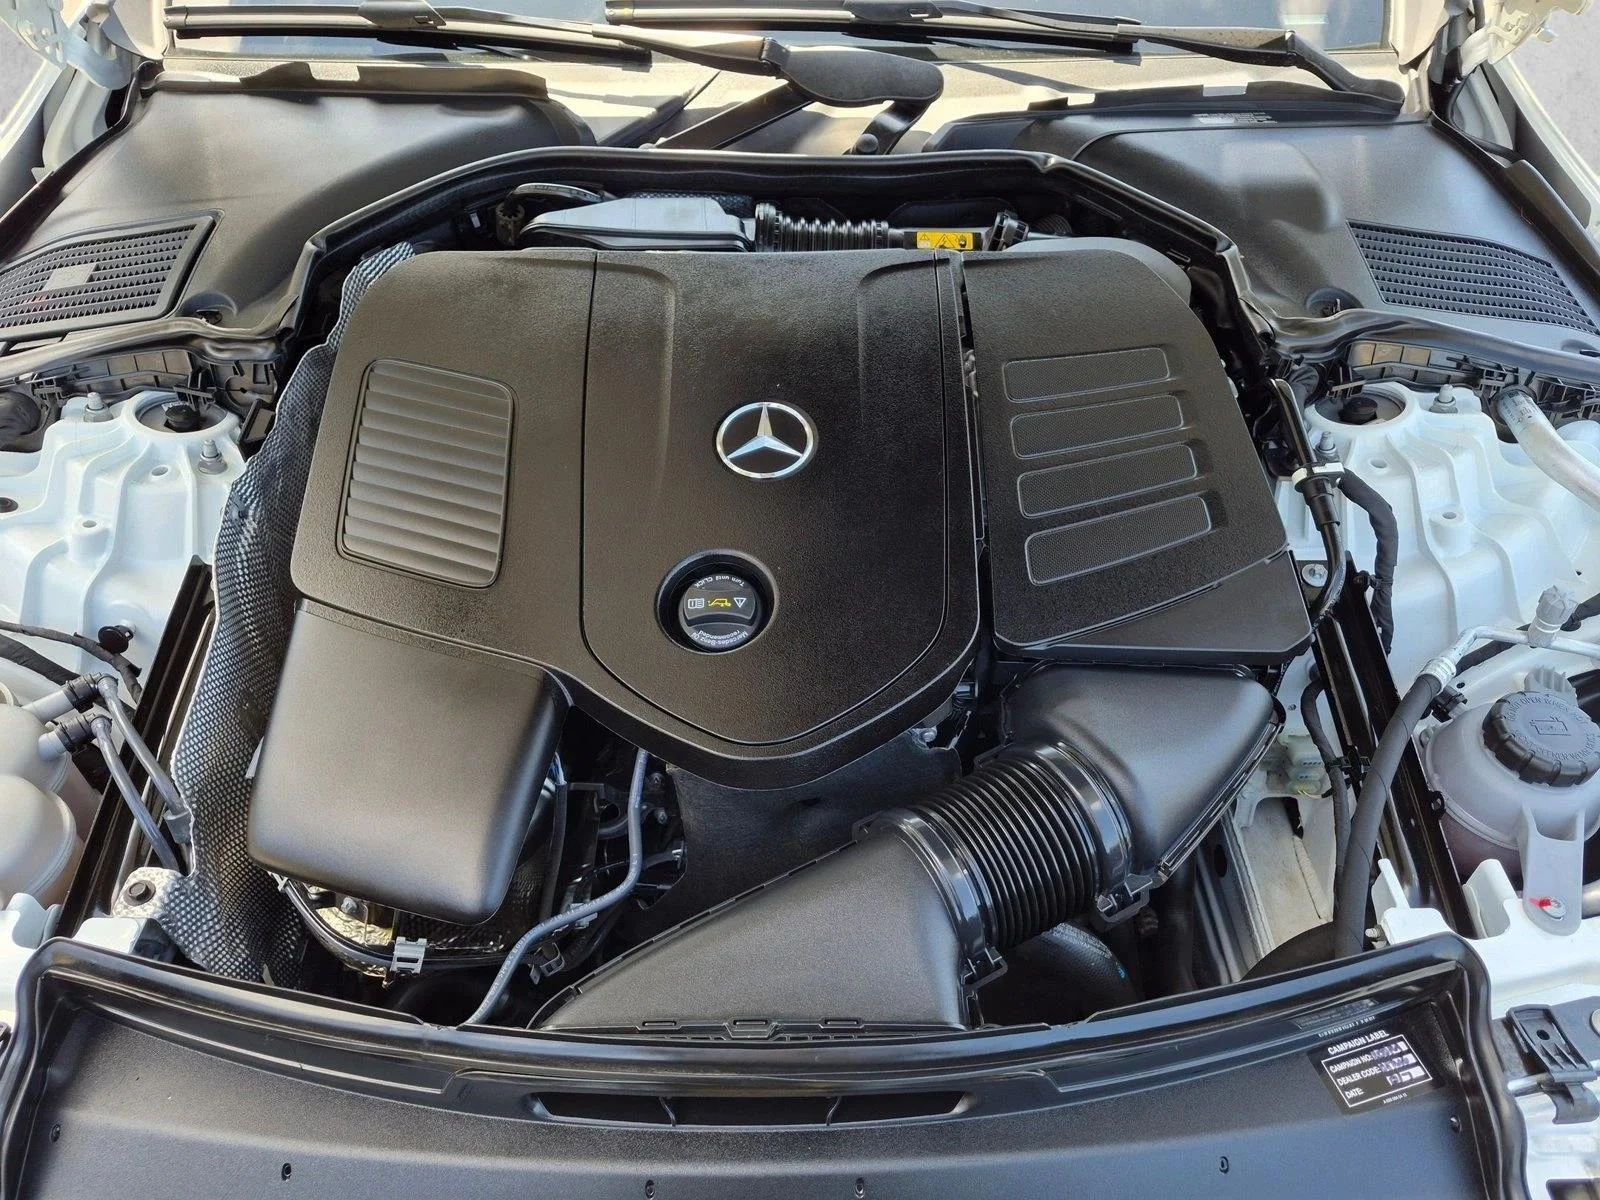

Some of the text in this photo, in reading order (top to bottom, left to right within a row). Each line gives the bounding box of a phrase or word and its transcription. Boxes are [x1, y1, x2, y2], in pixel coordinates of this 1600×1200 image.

[694, 577, 713, 588] CLICK
[732, 576, 745, 587] Turn
[699, 629, 740, 640] recommended
[701, 631, 748, 646] Mercedes-Benz
[1327, 1037, 1367, 1055] CAMPAIGN
[1366, 1029, 1390, 1043] LABEL
[1329, 1056, 1362, 1073] CAMPAIGN
[1337, 1066, 1381, 1086] DEALER CODE:
[1344, 1087, 1365, 1099] DATE:
